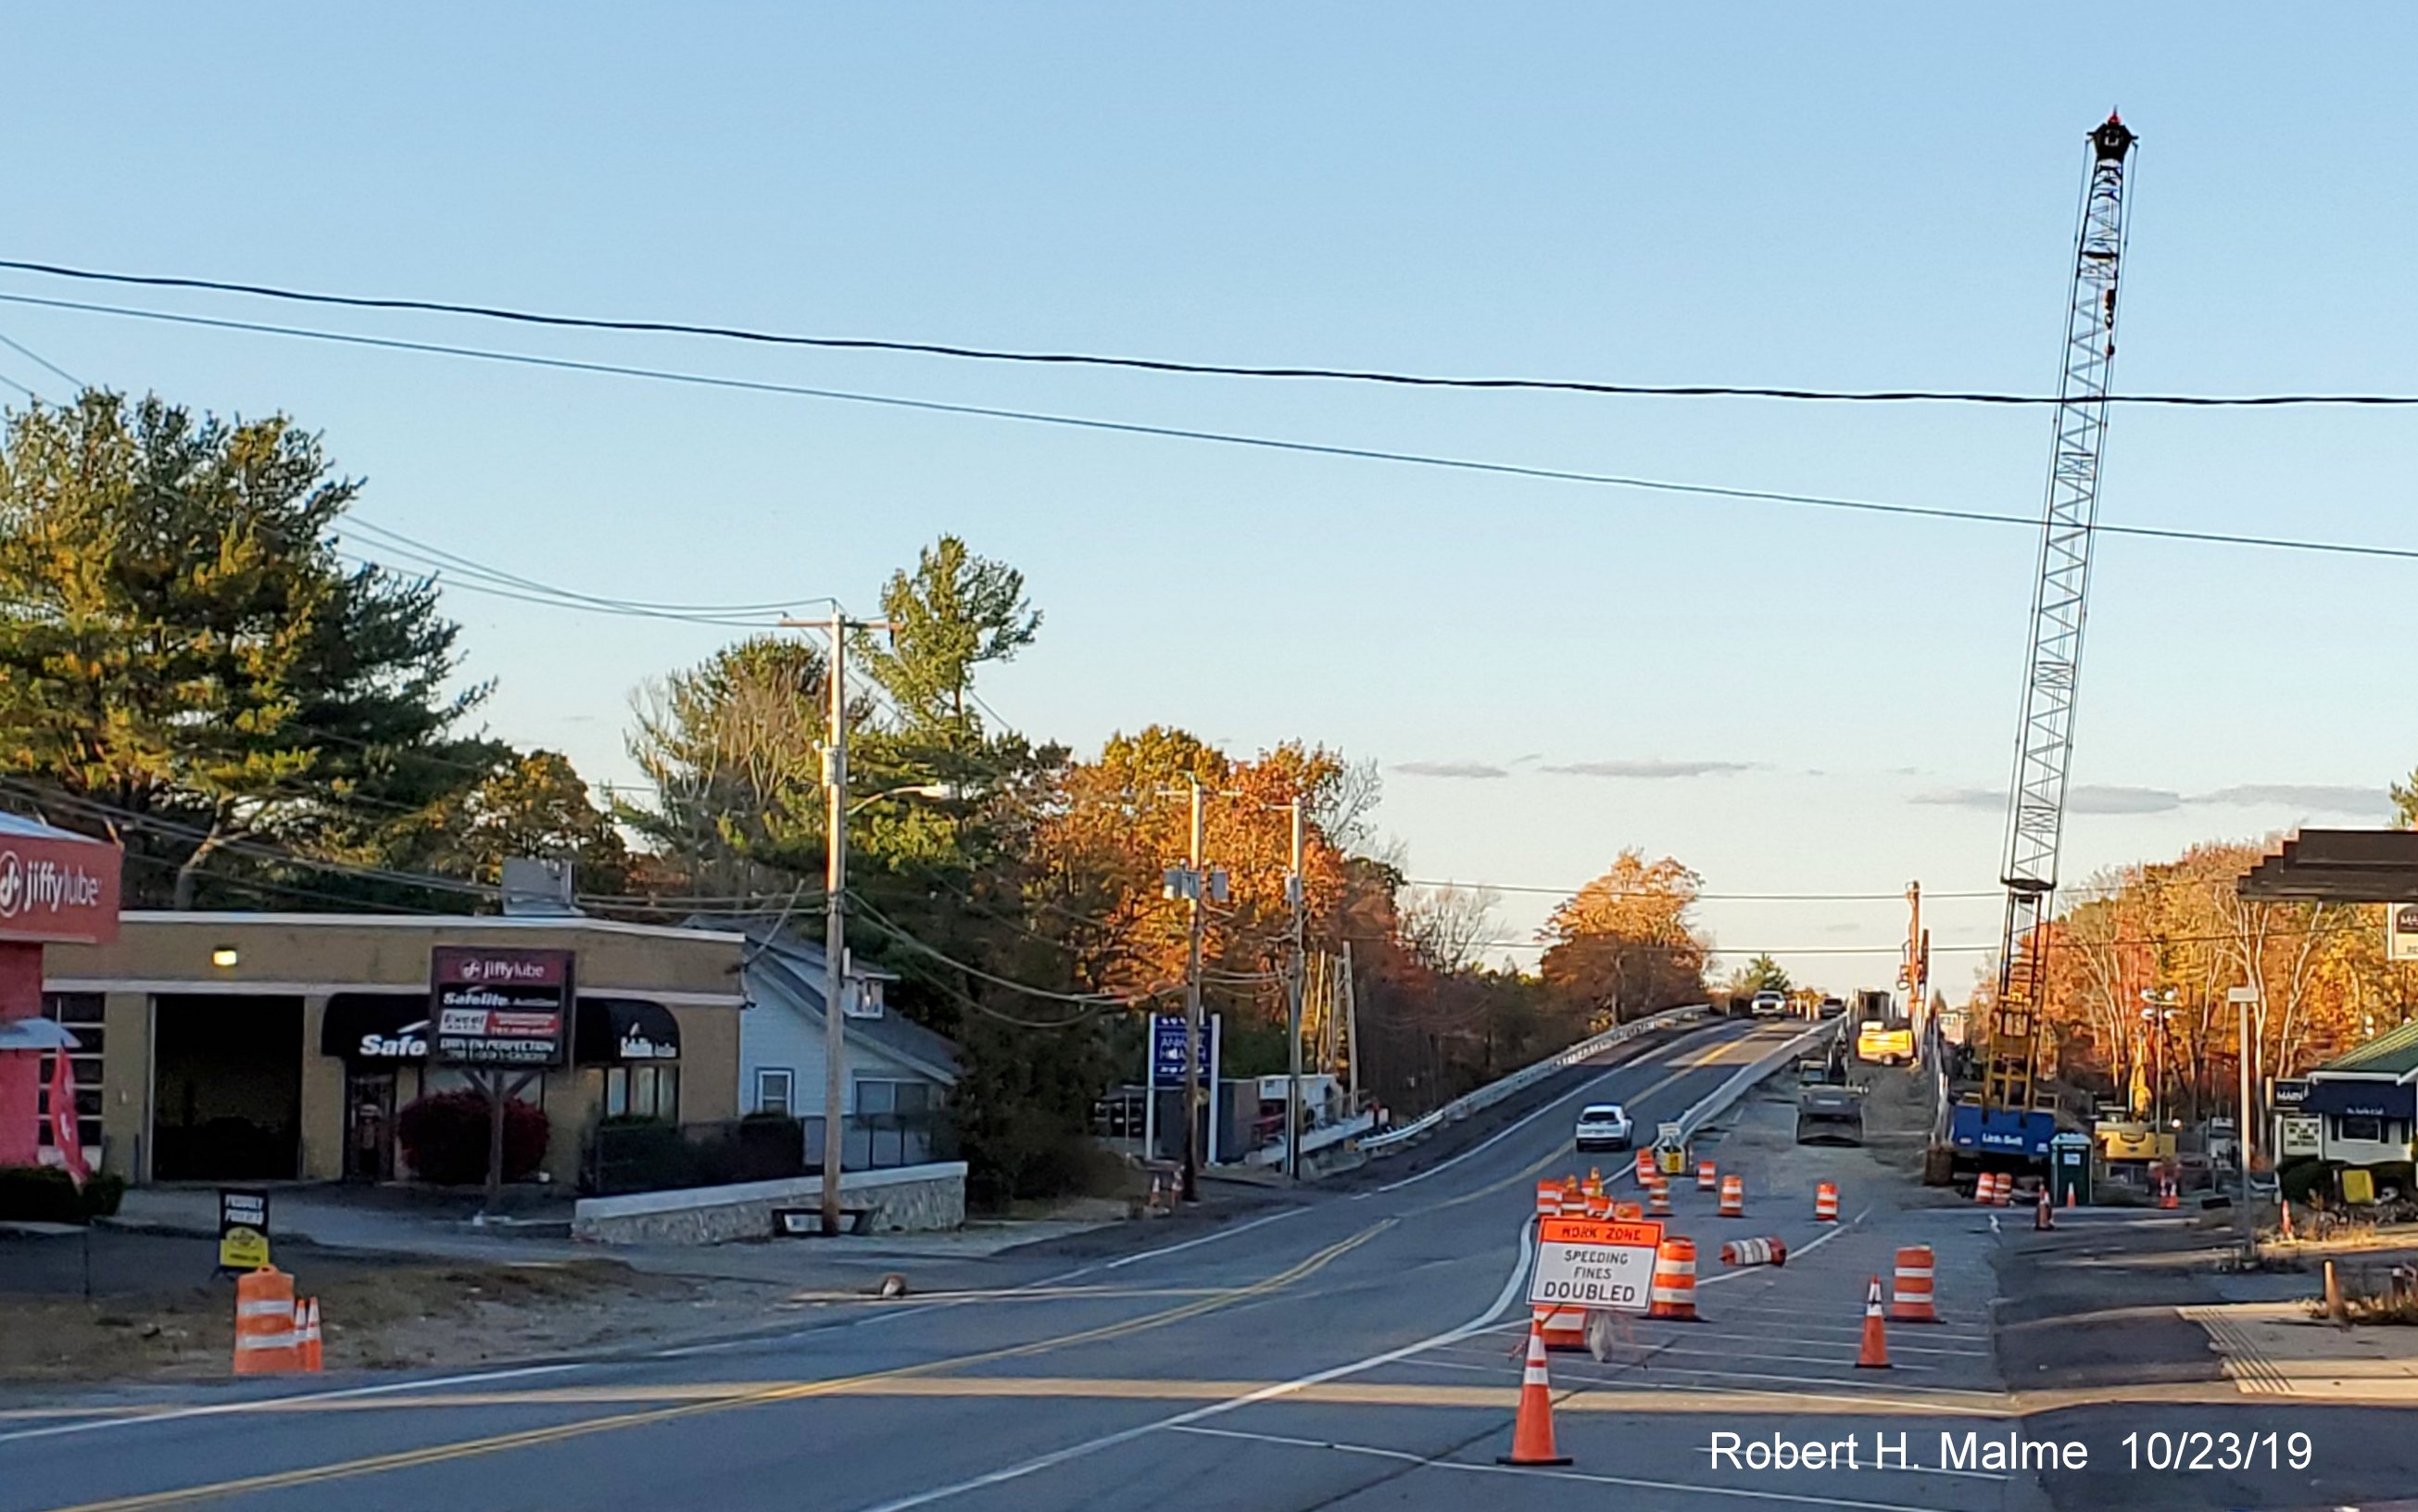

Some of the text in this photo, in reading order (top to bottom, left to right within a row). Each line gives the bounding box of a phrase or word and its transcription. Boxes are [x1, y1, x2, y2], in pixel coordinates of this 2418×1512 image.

[1561, 1227, 1641, 1241] WORK ZONE
[1564, 1249, 1629, 1266] SPEEDING
[1574, 1266, 1613, 1279] FINES
[1543, 1280, 1636, 1303] DOUBLED
